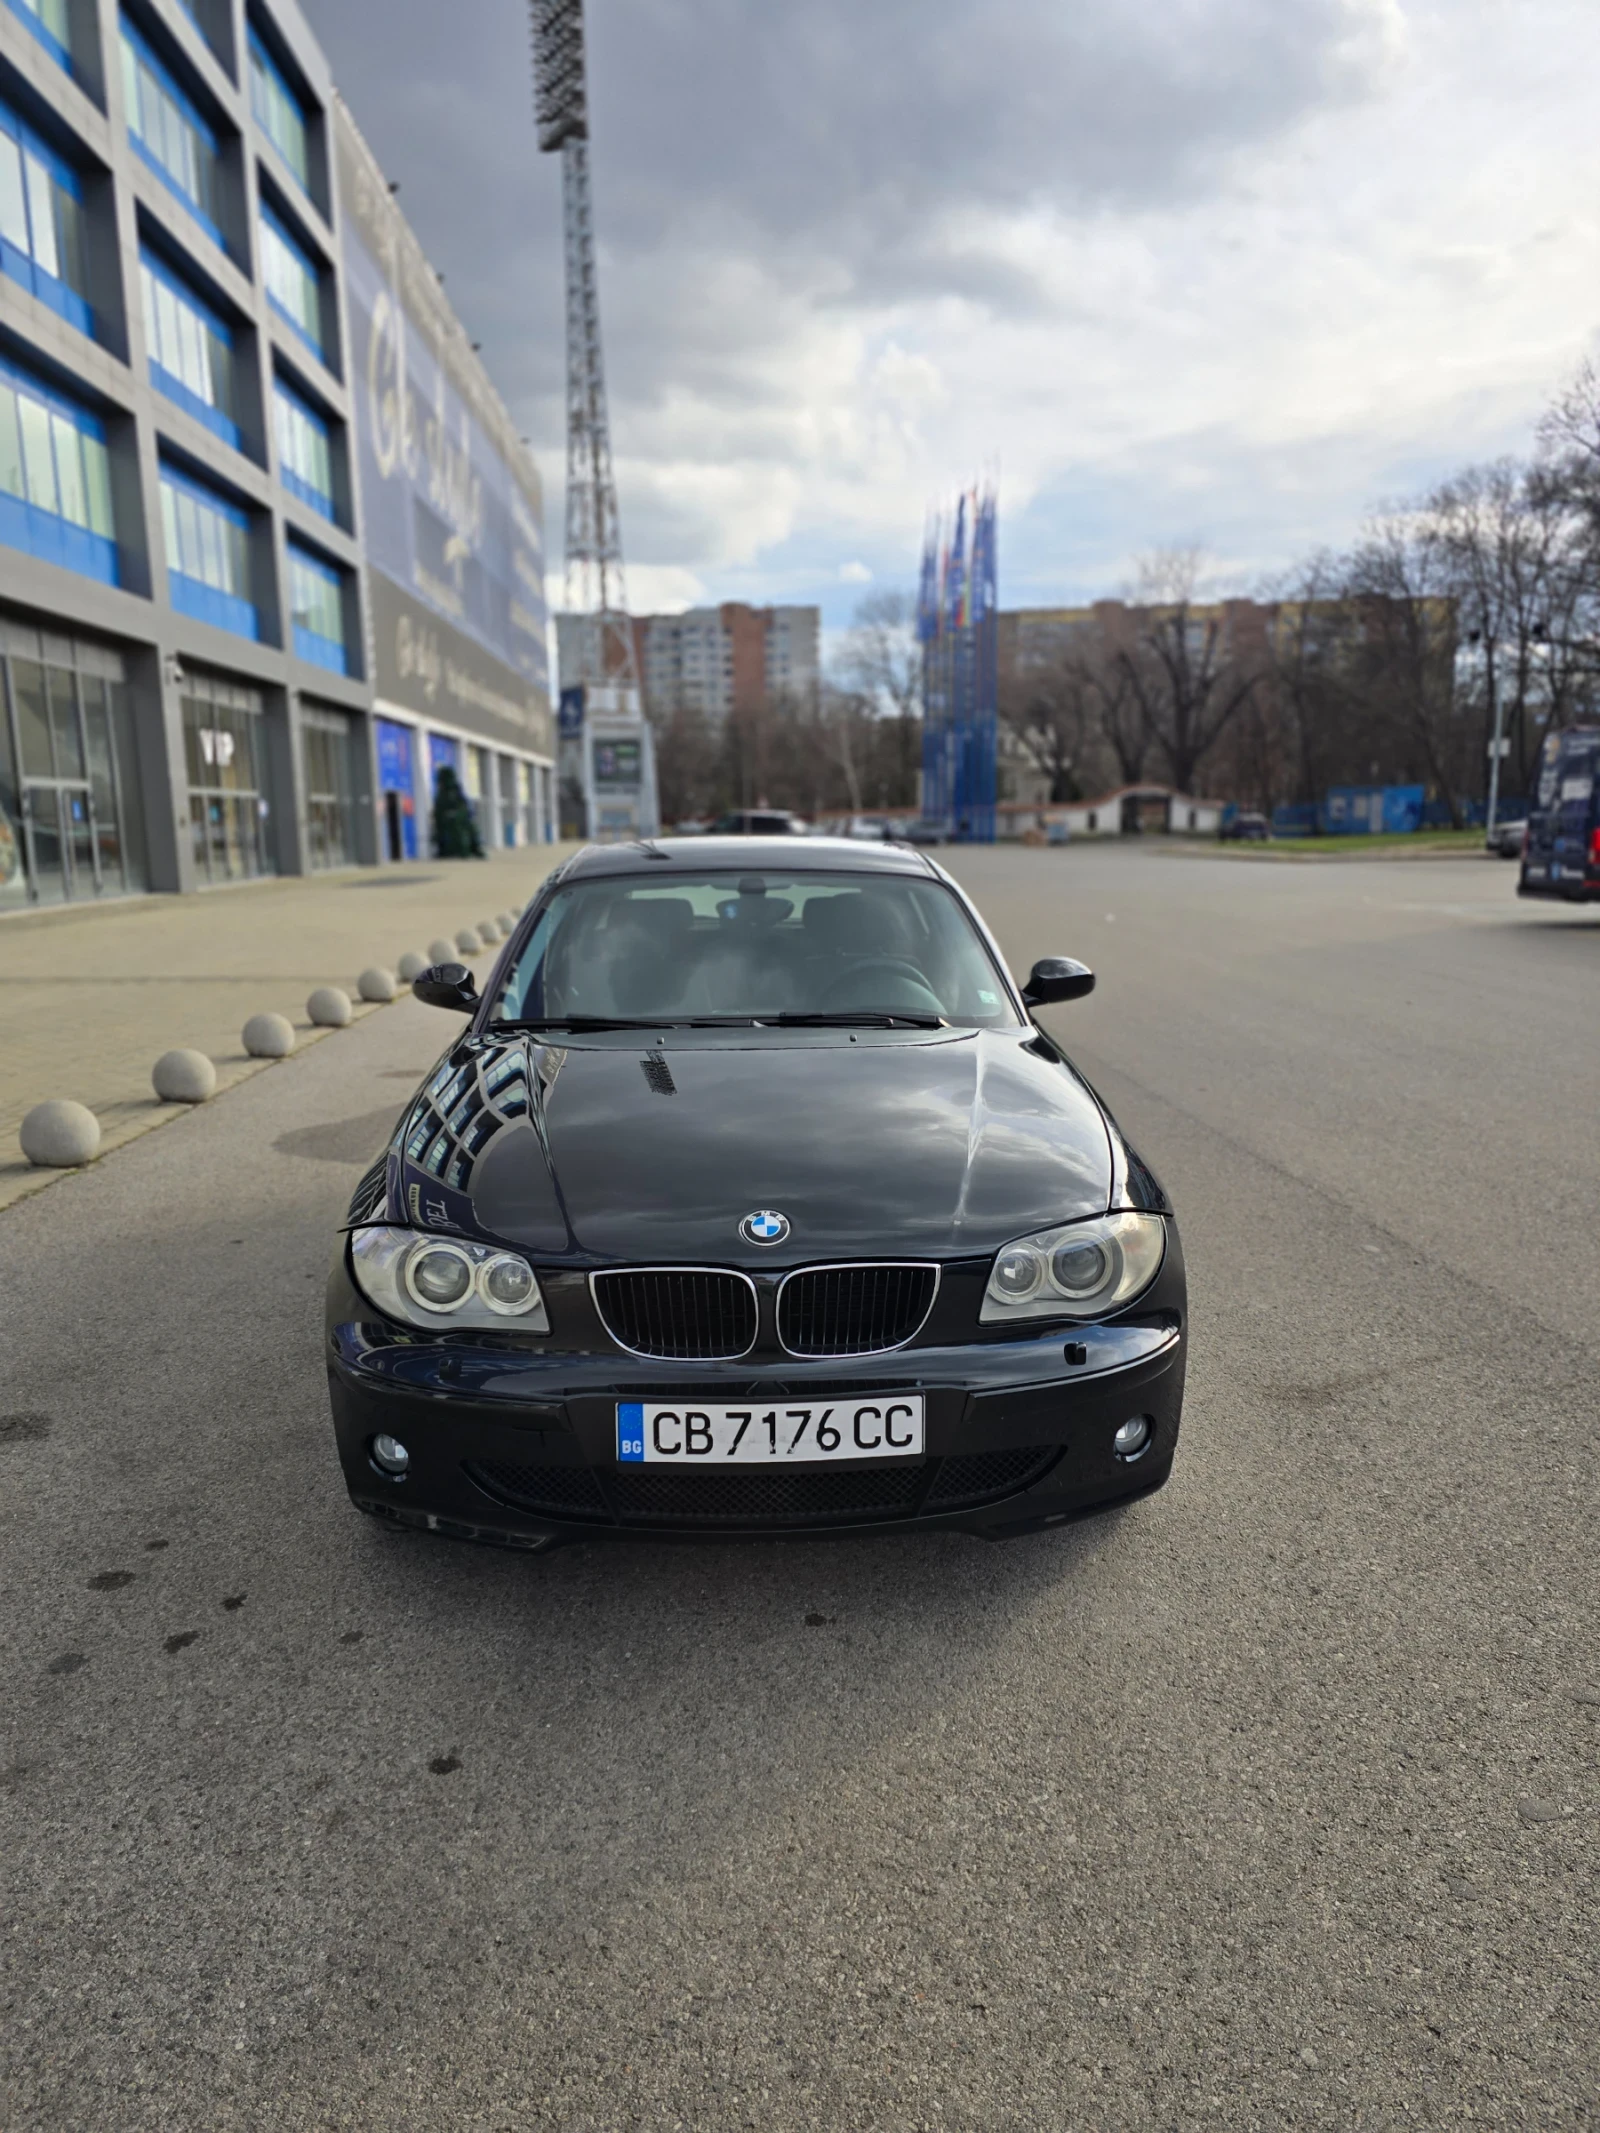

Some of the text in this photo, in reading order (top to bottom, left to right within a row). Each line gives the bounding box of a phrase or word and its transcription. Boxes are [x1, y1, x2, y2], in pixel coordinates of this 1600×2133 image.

[200, 729, 234, 766] VIP
[747, 1210, 786, 1222] BMW
[652, 1404, 914, 1456] CB 7176 CC
[621, 1439, 642, 1454] BG
